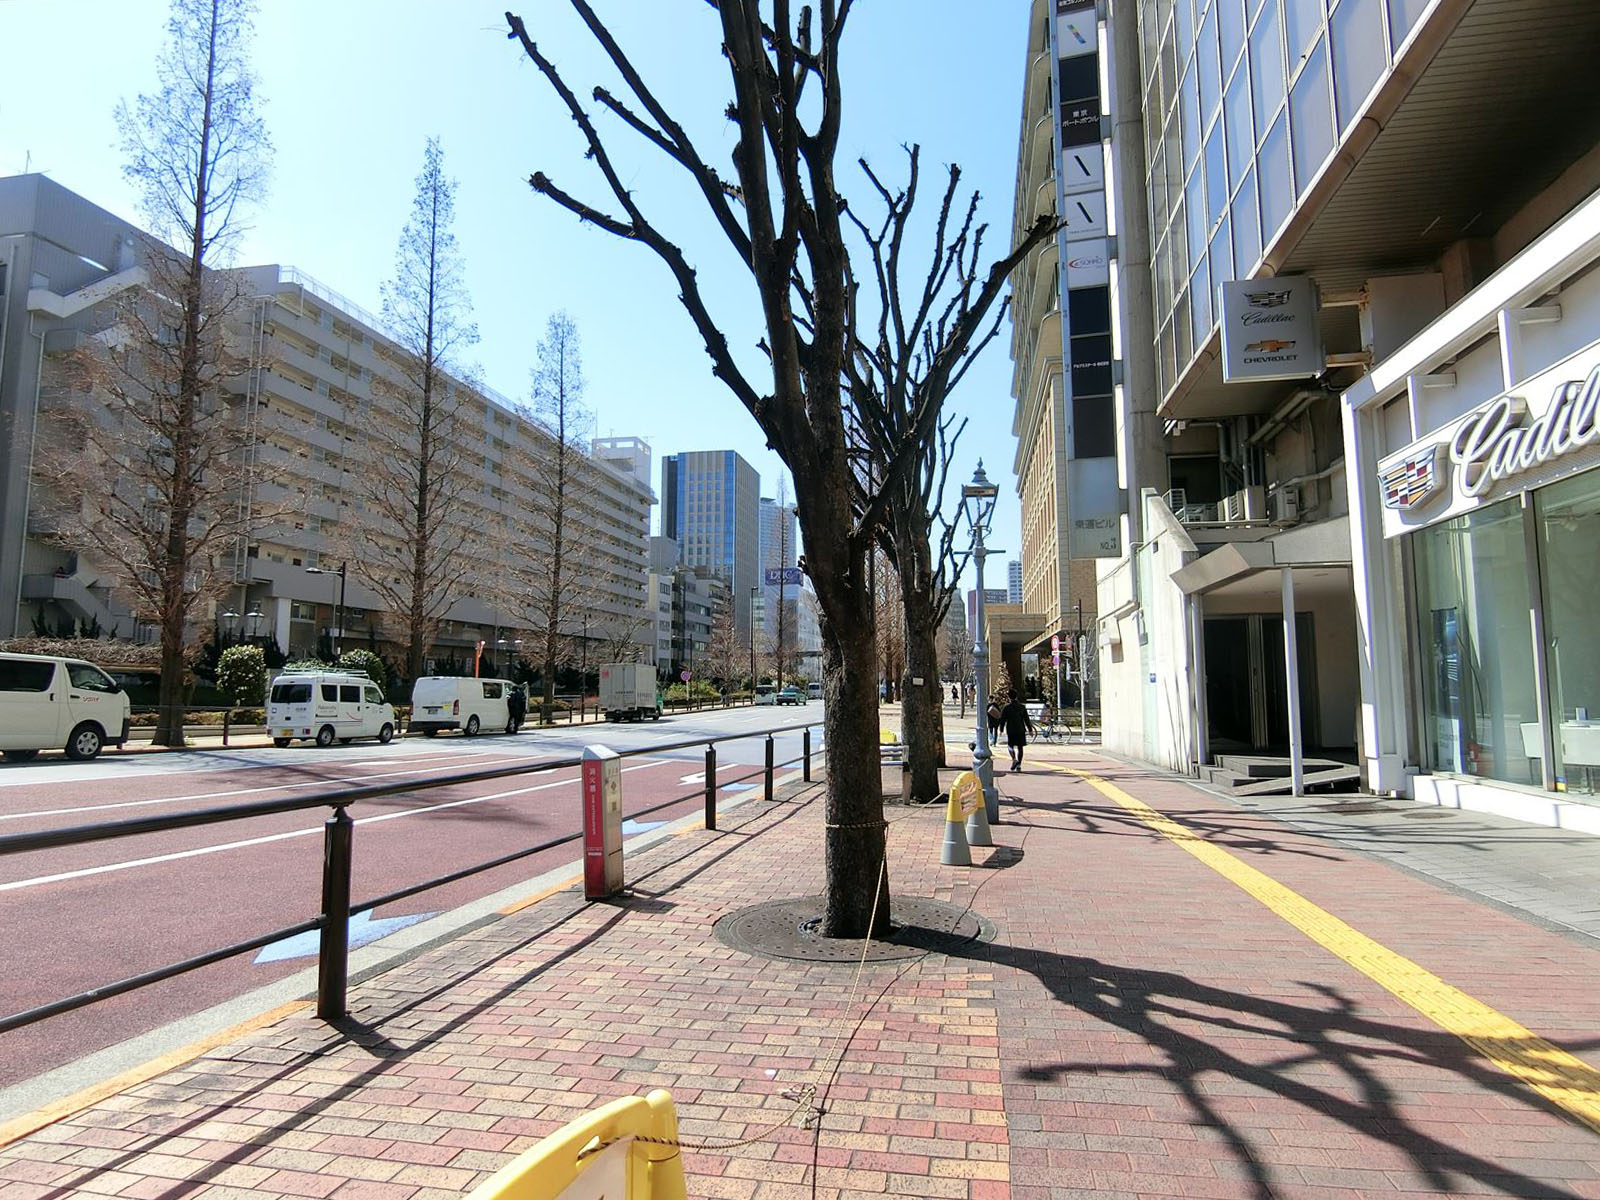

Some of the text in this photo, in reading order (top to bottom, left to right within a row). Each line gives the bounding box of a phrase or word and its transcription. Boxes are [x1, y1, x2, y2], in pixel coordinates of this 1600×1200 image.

[1241, 311, 1295, 326] Cadillac
[1243, 354, 1298, 364] CHEVROLET
[1450, 363, 1600, 498] Cadil
